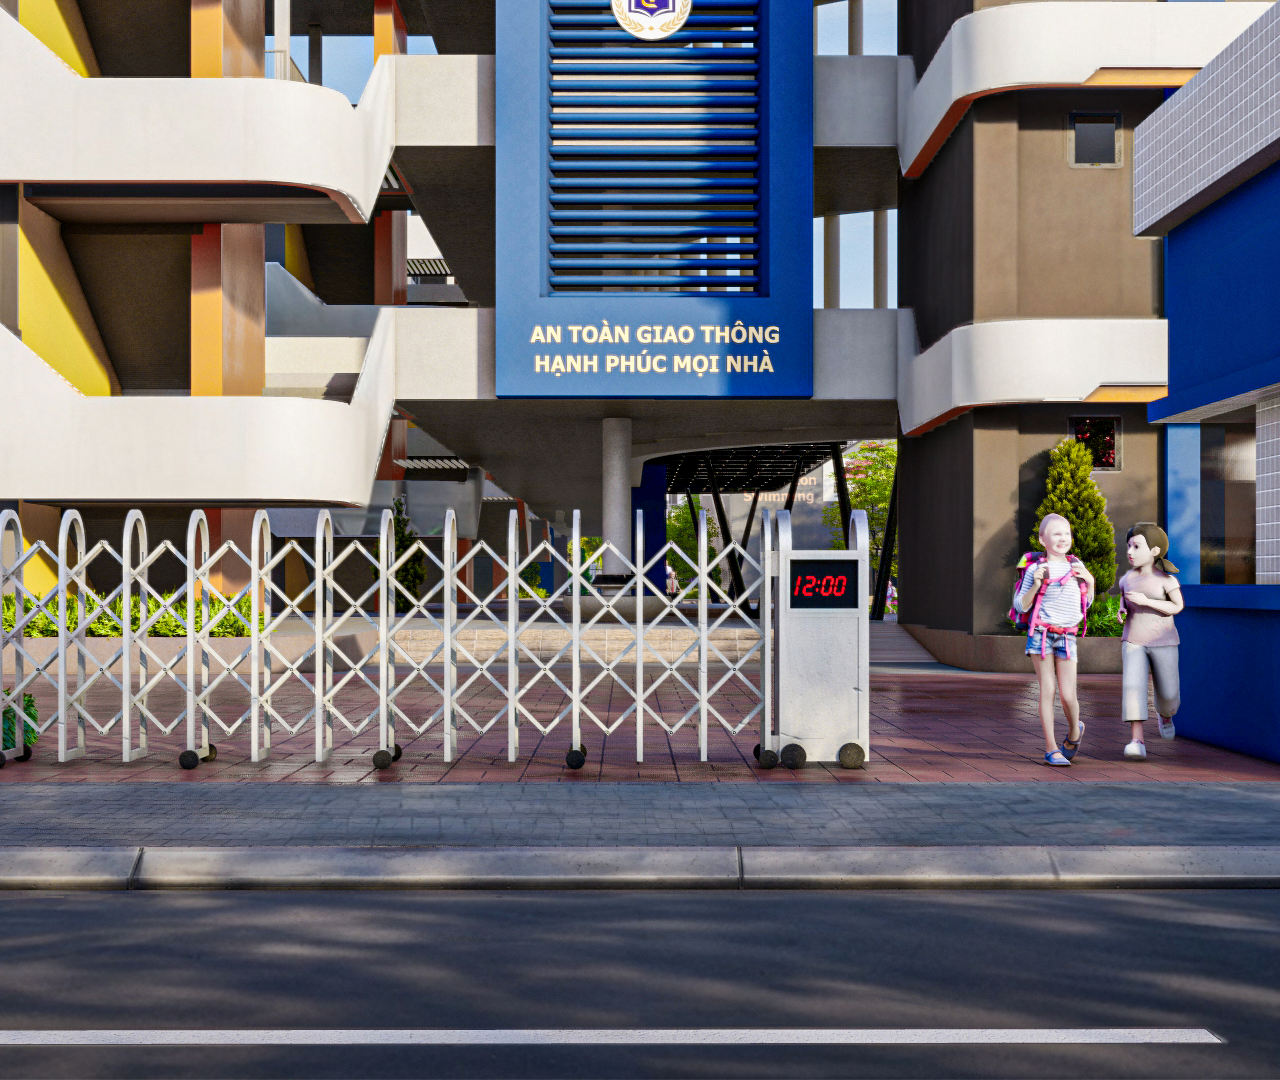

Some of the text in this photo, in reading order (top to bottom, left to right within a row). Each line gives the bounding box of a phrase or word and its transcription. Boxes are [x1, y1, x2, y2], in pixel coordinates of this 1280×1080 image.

[529, 319, 780, 344] AN TOÀN GIAO THÔNG
[534, 349, 774, 378] HẠNH PHÚC MỌI NHÀ
[793, 575, 847, 596] 12:00
